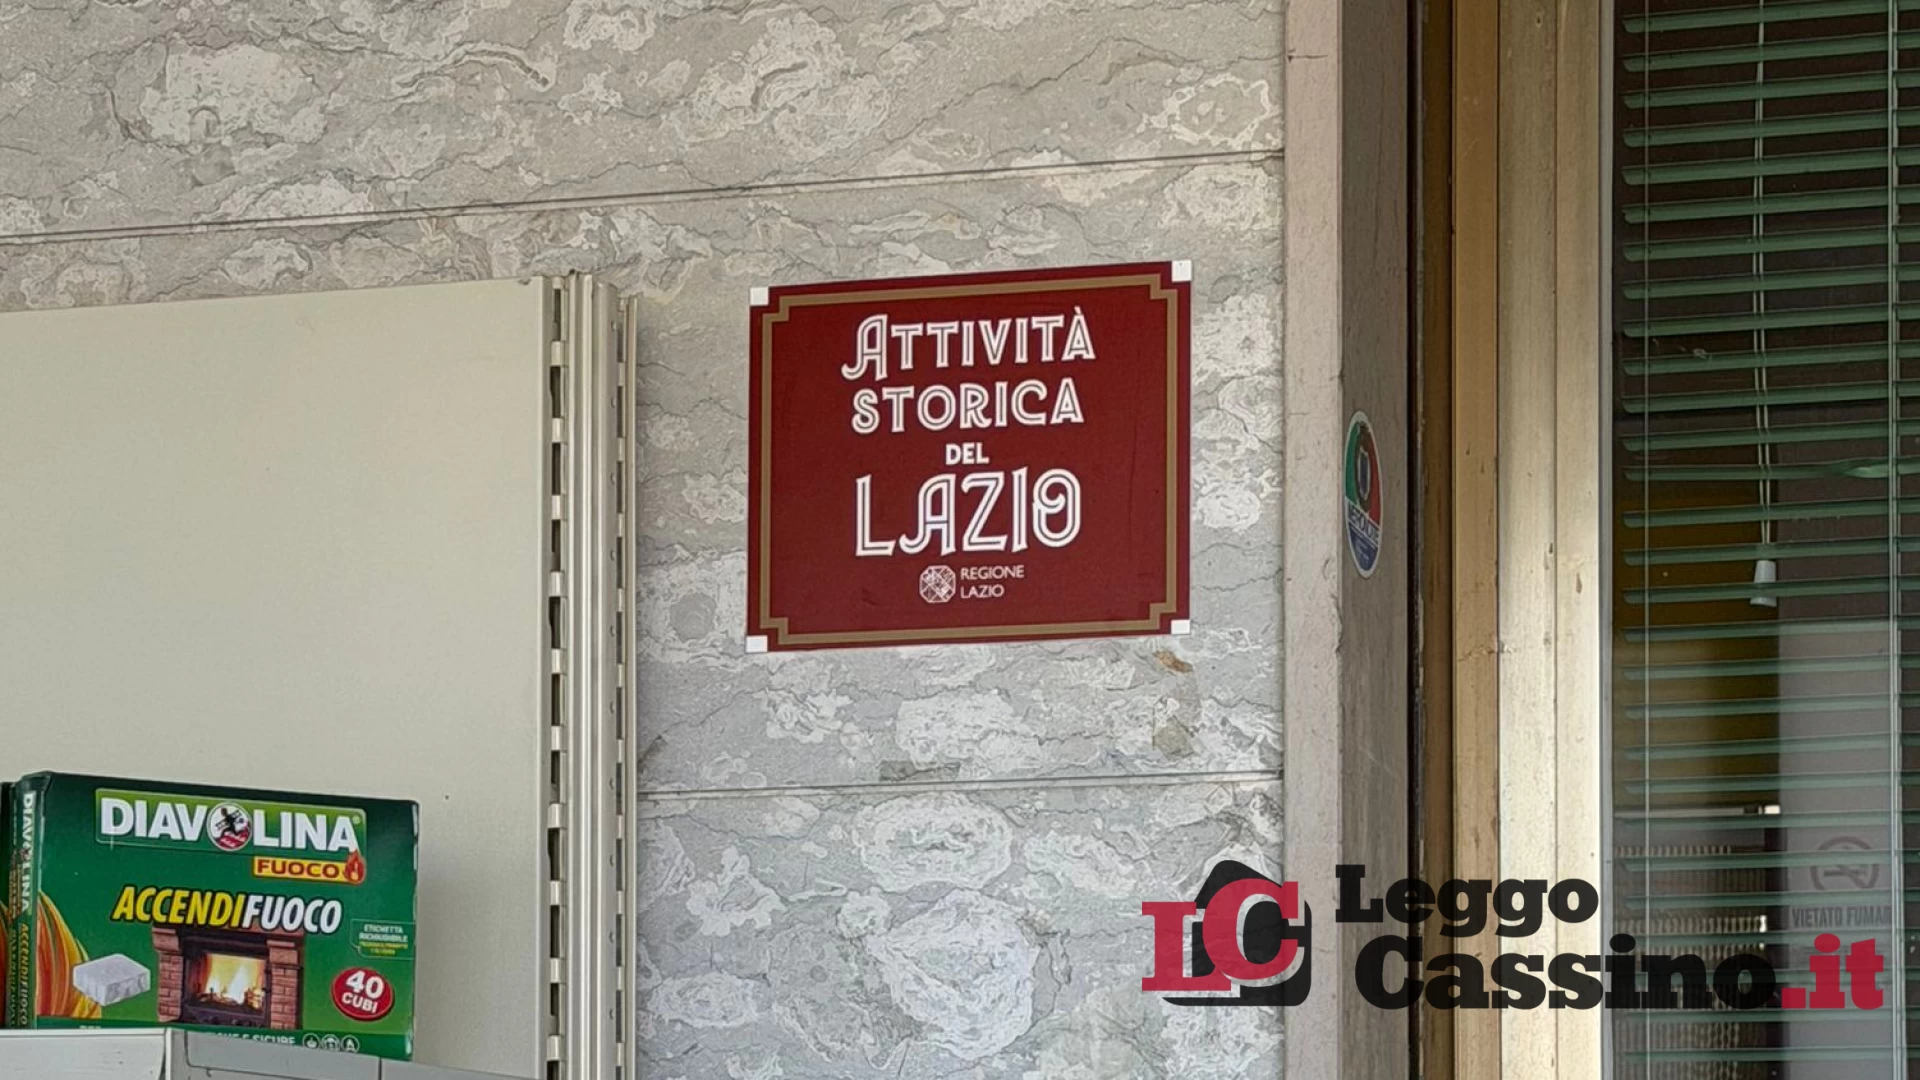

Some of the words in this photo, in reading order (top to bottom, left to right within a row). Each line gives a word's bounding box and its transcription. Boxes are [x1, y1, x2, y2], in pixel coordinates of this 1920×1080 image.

[841, 305, 1096, 381] ATTIVITÀ
[851, 377, 1085, 435] STORICA
[945, 442, 989, 466] DEL
[855, 466, 1081, 558] LAZIO
[960, 565, 1025, 581] REGIONE
[960, 584, 1005, 600] LAZIO
[100, 797, 358, 854] DIAVOLINA
[256, 858, 340, 879] FUOCO
[112, 886, 343, 934] ACCENDIFUOCO
[1791, 906, 1843, 929] VIETATO
[346, 971, 385, 998] 40
[341, 991, 378, 1014] CUBI
